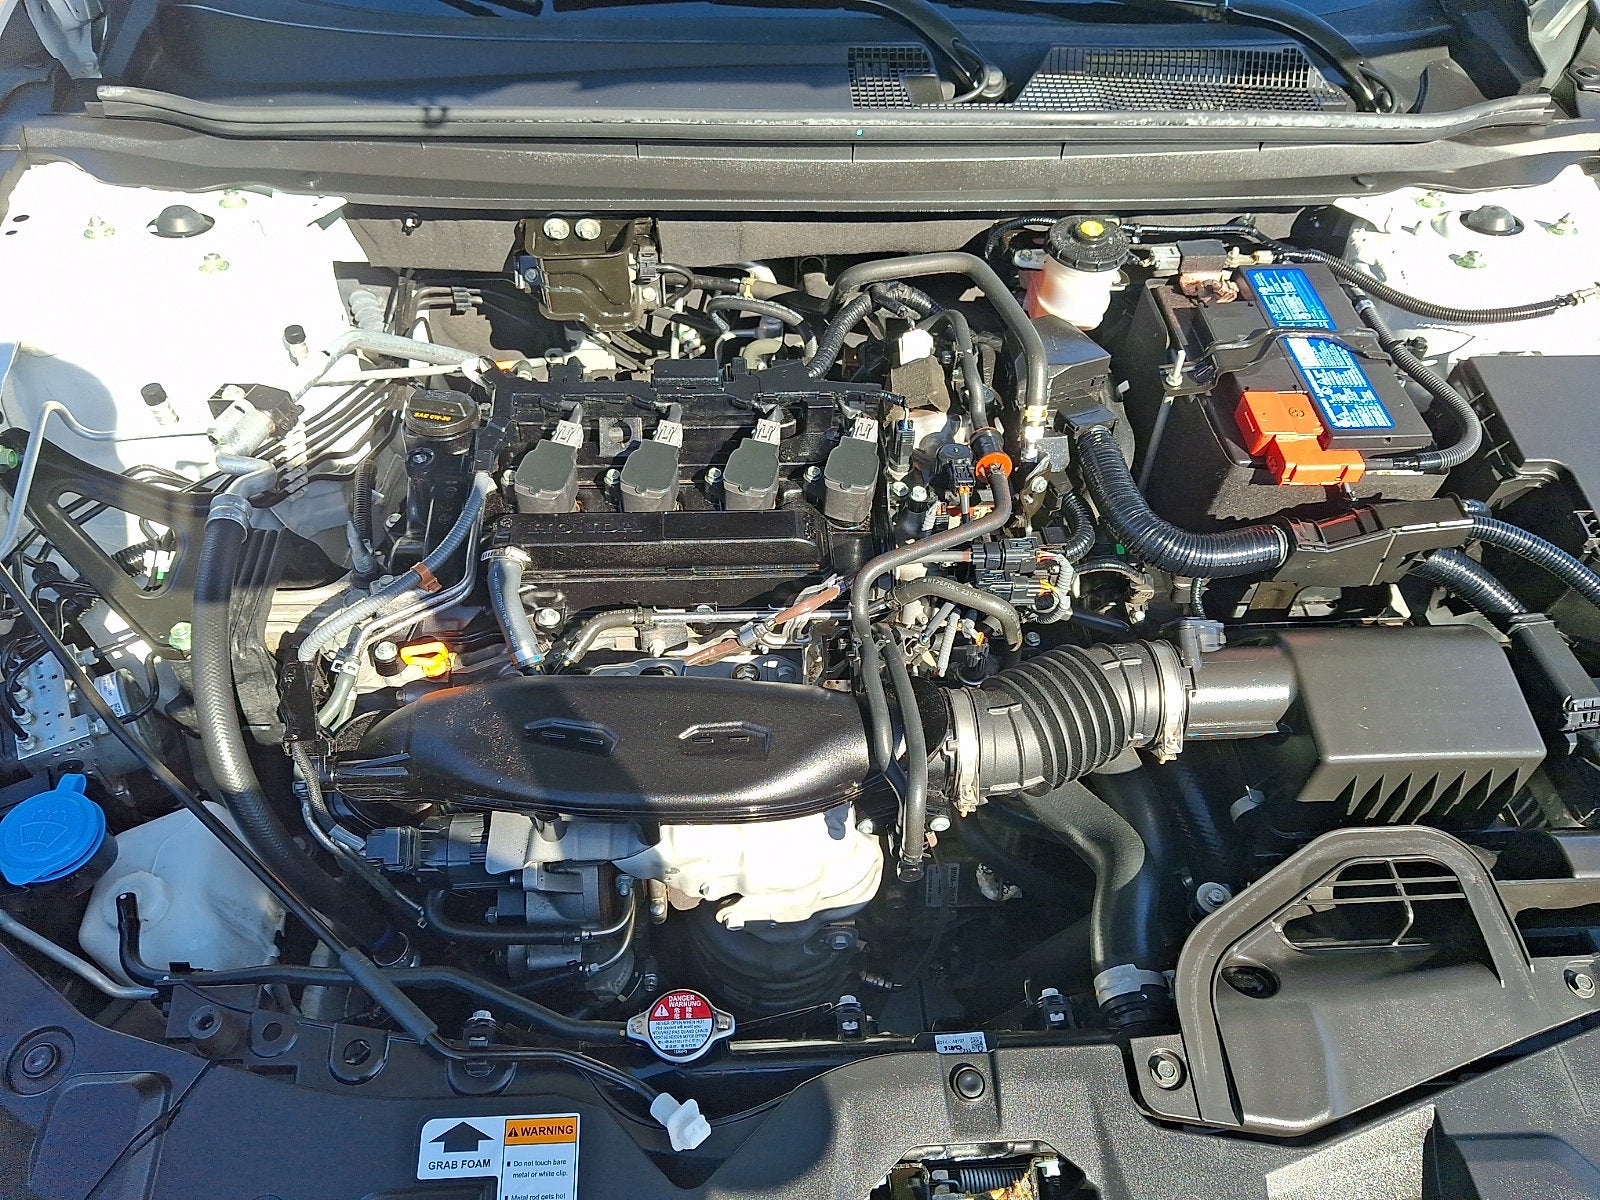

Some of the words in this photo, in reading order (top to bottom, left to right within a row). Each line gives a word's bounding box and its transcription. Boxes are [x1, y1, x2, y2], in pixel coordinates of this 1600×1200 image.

[520, 1124, 574, 1137] WARNING
[428, 1160, 458, 1171] GRAB
[460, 1158, 491, 1169] FOAM
[512, 1171, 530, 1179] metal
